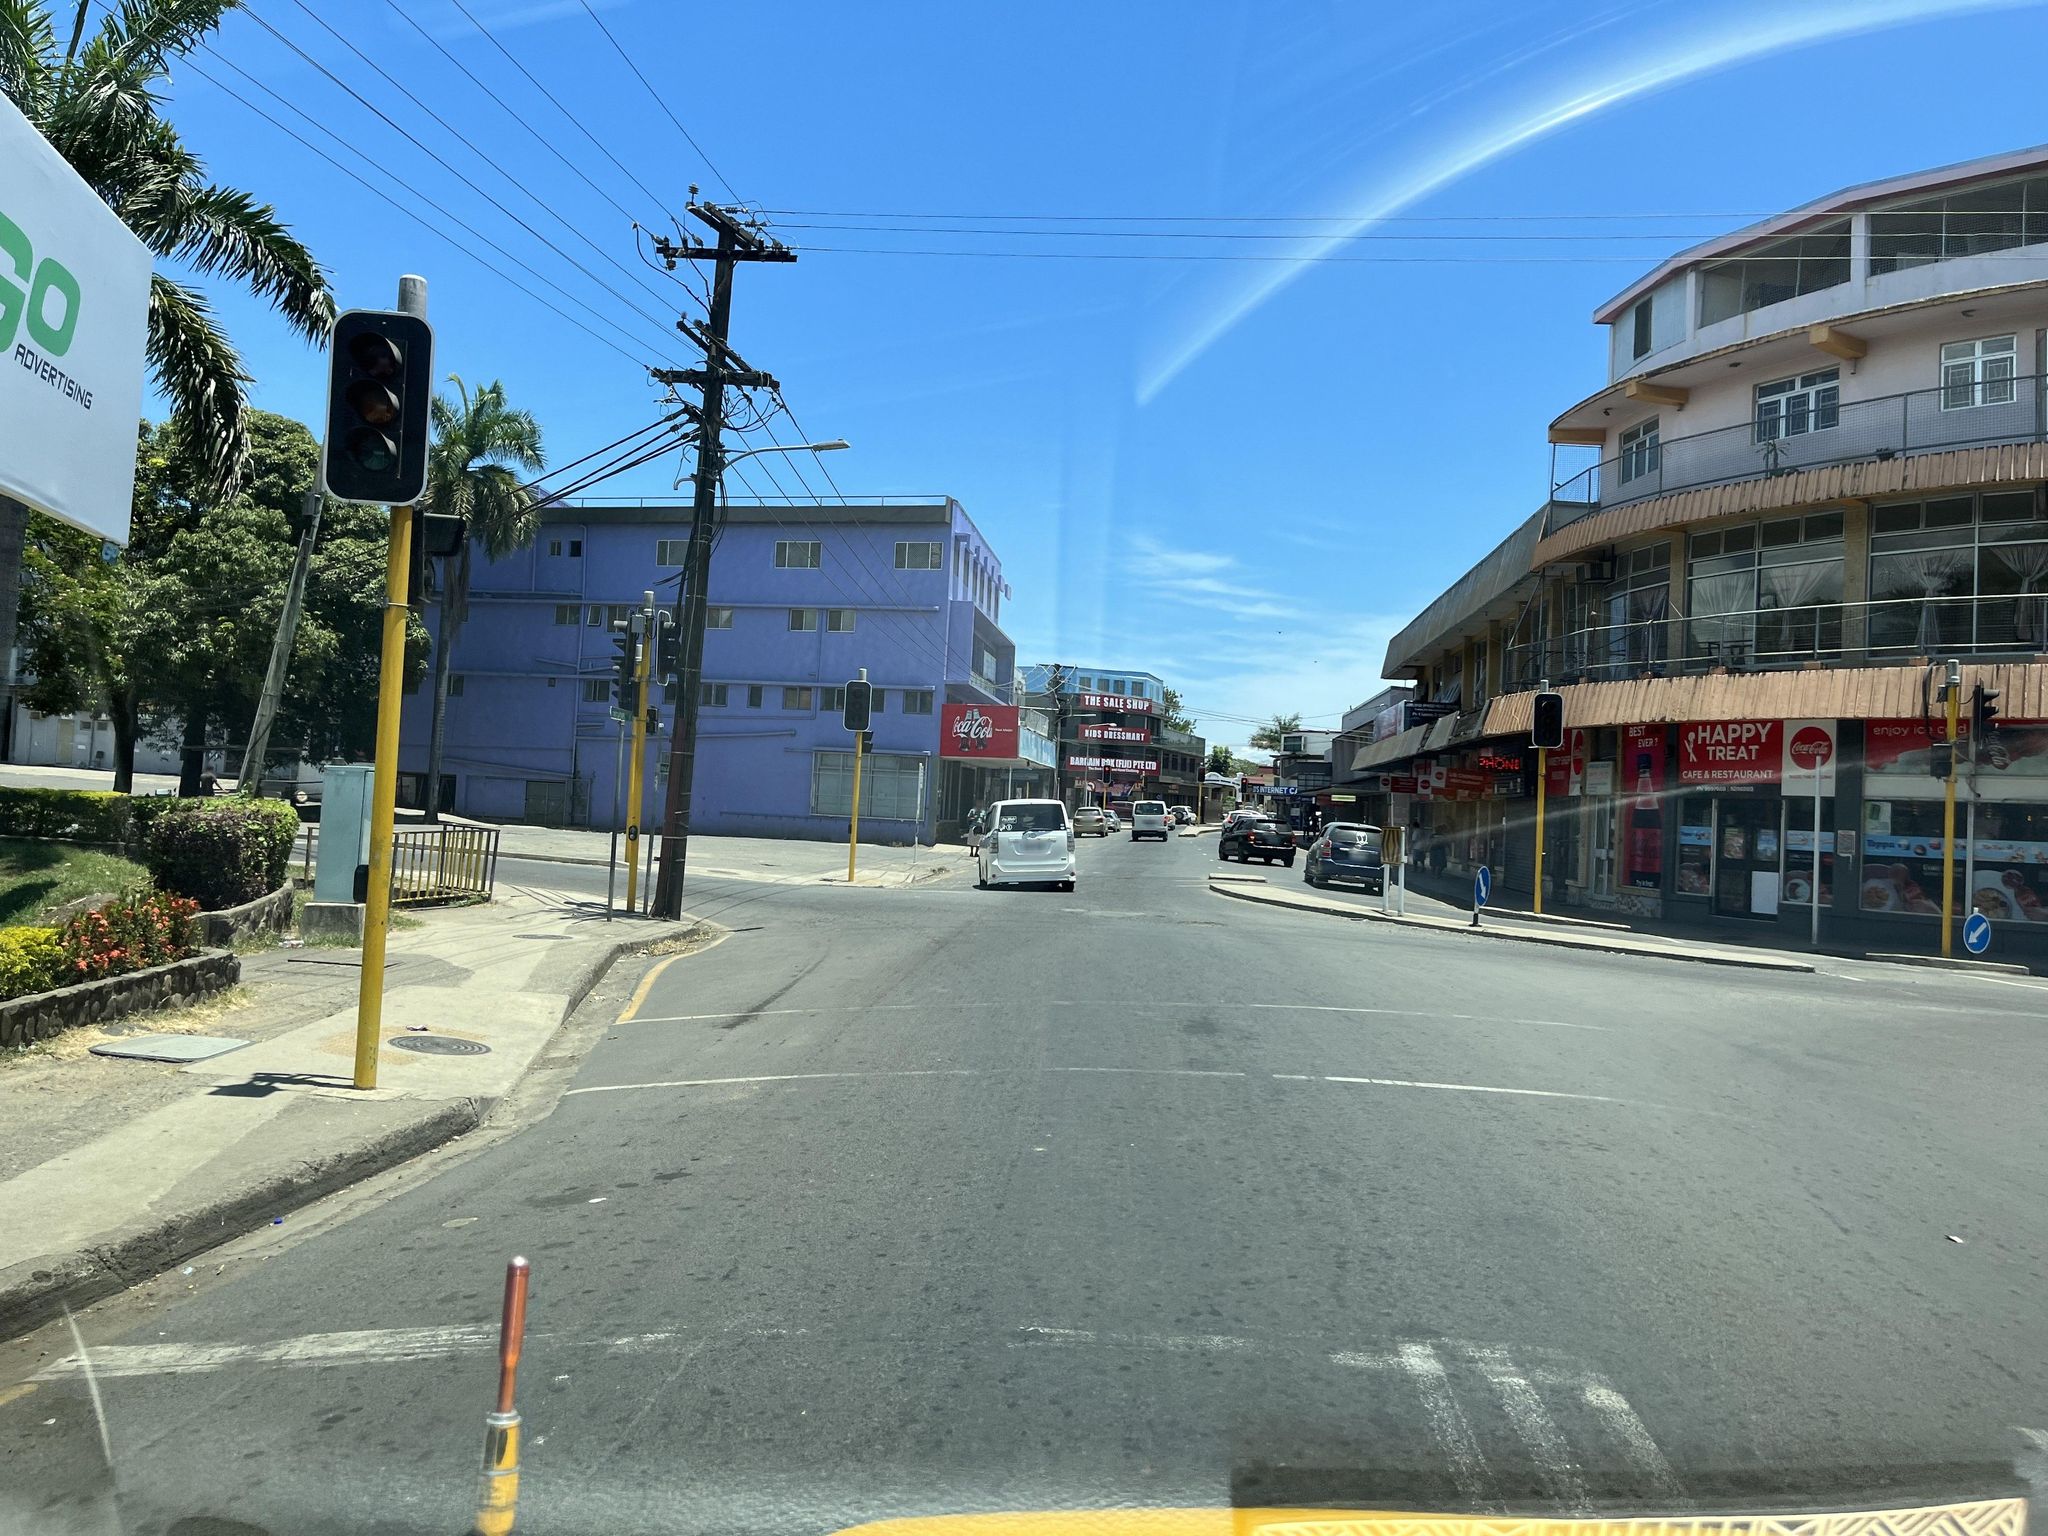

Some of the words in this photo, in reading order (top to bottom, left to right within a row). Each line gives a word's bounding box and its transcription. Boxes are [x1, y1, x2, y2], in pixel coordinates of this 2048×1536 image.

[14, 342, 94, 411] ADVERTISING
[1084, 695, 1101, 707] THE
[1103, 697, 1124, 709] SALE
[1126, 699, 1150, 711] SHOP
[1103, 731, 1146, 742] DRESSMART
[1628, 725, 1646, 737] BEST
[1697, 722, 1773, 745] HAPPY
[1873, 724, 1910, 737] enjoy
[1913, 724, 1933, 735] ic
[1937, 723, 1967, 735] cd
[1706, 745, 1760, 761] TREAT
[1791, 741, 1830, 755] Coca-Cola
[1132, 760, 1145, 770] PTE
[1145, 761, 1157, 771] LTD
[1682, 770, 1702, 779] CAFE
[1703, 770, 1710, 779] &
[1712, 769, 1774, 779] RESTAURANT
[1260, 786, 1288, 794] INTERNET
